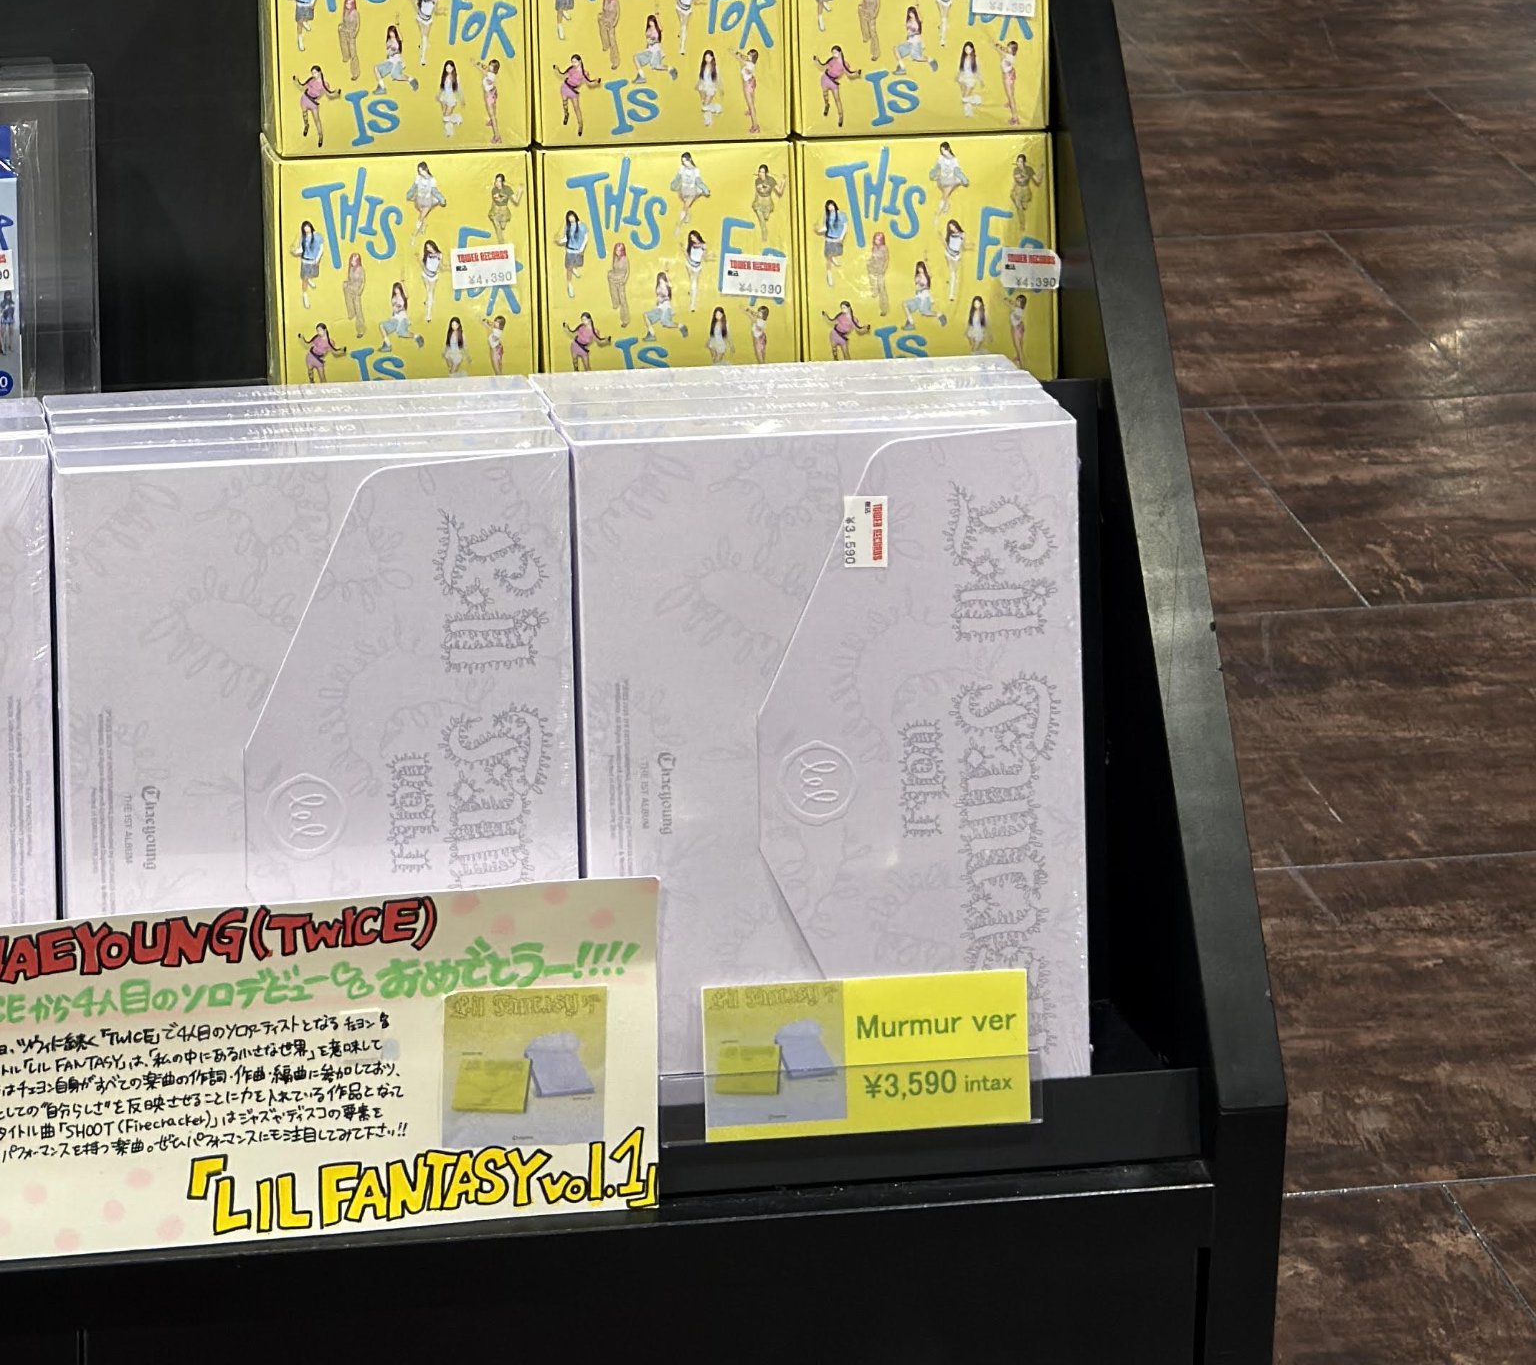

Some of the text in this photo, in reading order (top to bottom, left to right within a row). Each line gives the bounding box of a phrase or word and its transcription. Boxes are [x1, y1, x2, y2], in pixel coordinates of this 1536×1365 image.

[344, 88, 400, 146] IS
[856, 1014, 1017, 1039] Murmur ver
[964, 1074, 1012, 1093] intax
[318, 1147, 550, 1229] FANTASY
